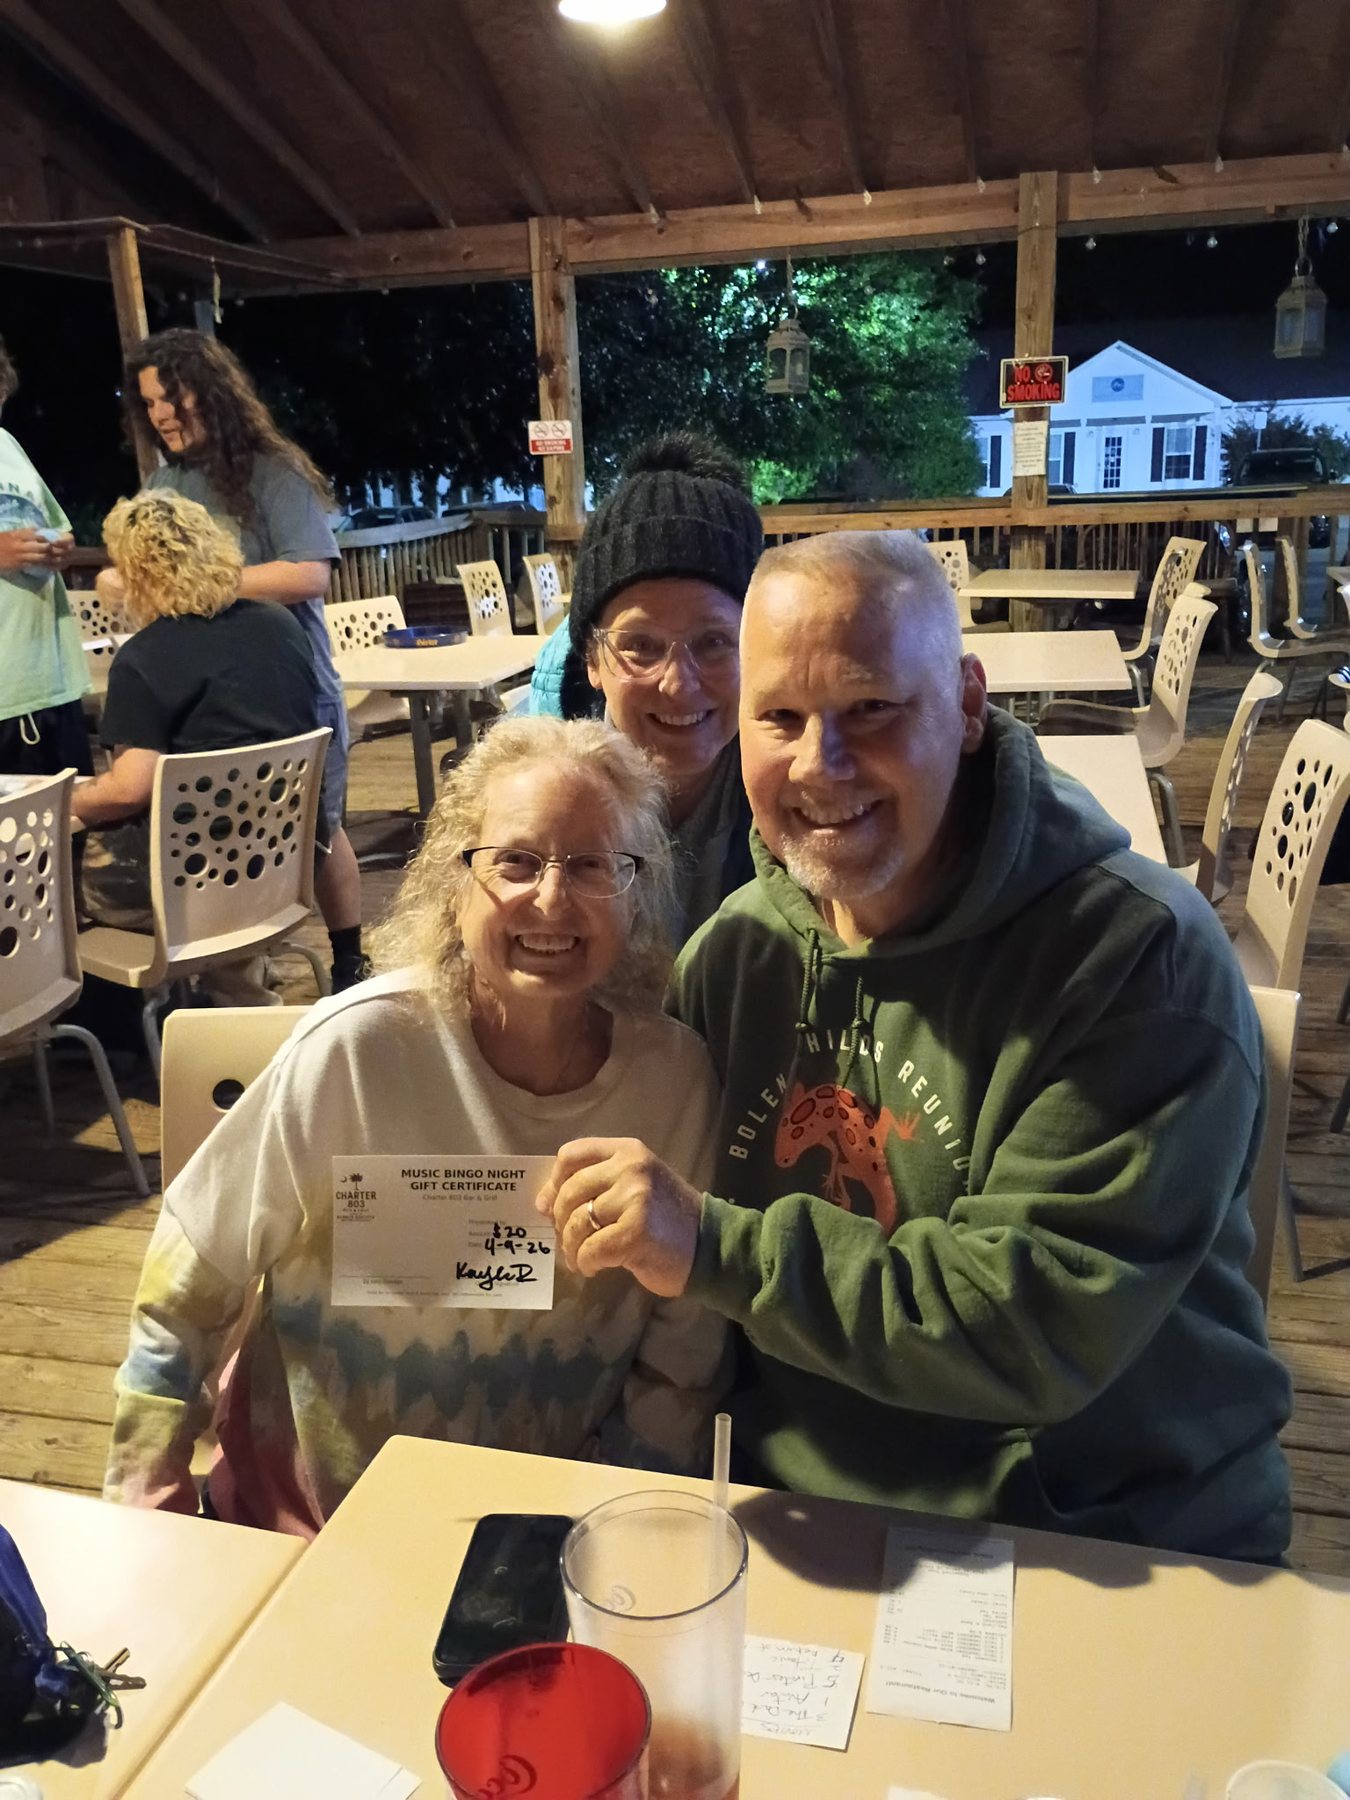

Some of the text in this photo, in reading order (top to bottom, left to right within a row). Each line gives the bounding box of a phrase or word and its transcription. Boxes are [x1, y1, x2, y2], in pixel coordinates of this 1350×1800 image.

[1014, 365, 1031, 382] NO
[1007, 382, 1060, 402] SMOKING
[728, 1073, 788, 1160] BOLEN
[897, 1060, 971, 1191] REUNIO
[401, 1169, 526, 1179] MUSIC BINGO NIGHT
[410, 1181, 517, 1191] GIFT CERTIFICATE
[335, 1191, 377, 1200] CHARTER
[347, 1200, 365, 1208] 803
[493, 1223, 527, 1239] $20
[485, 1238, 551, 1256] 4-9-26
